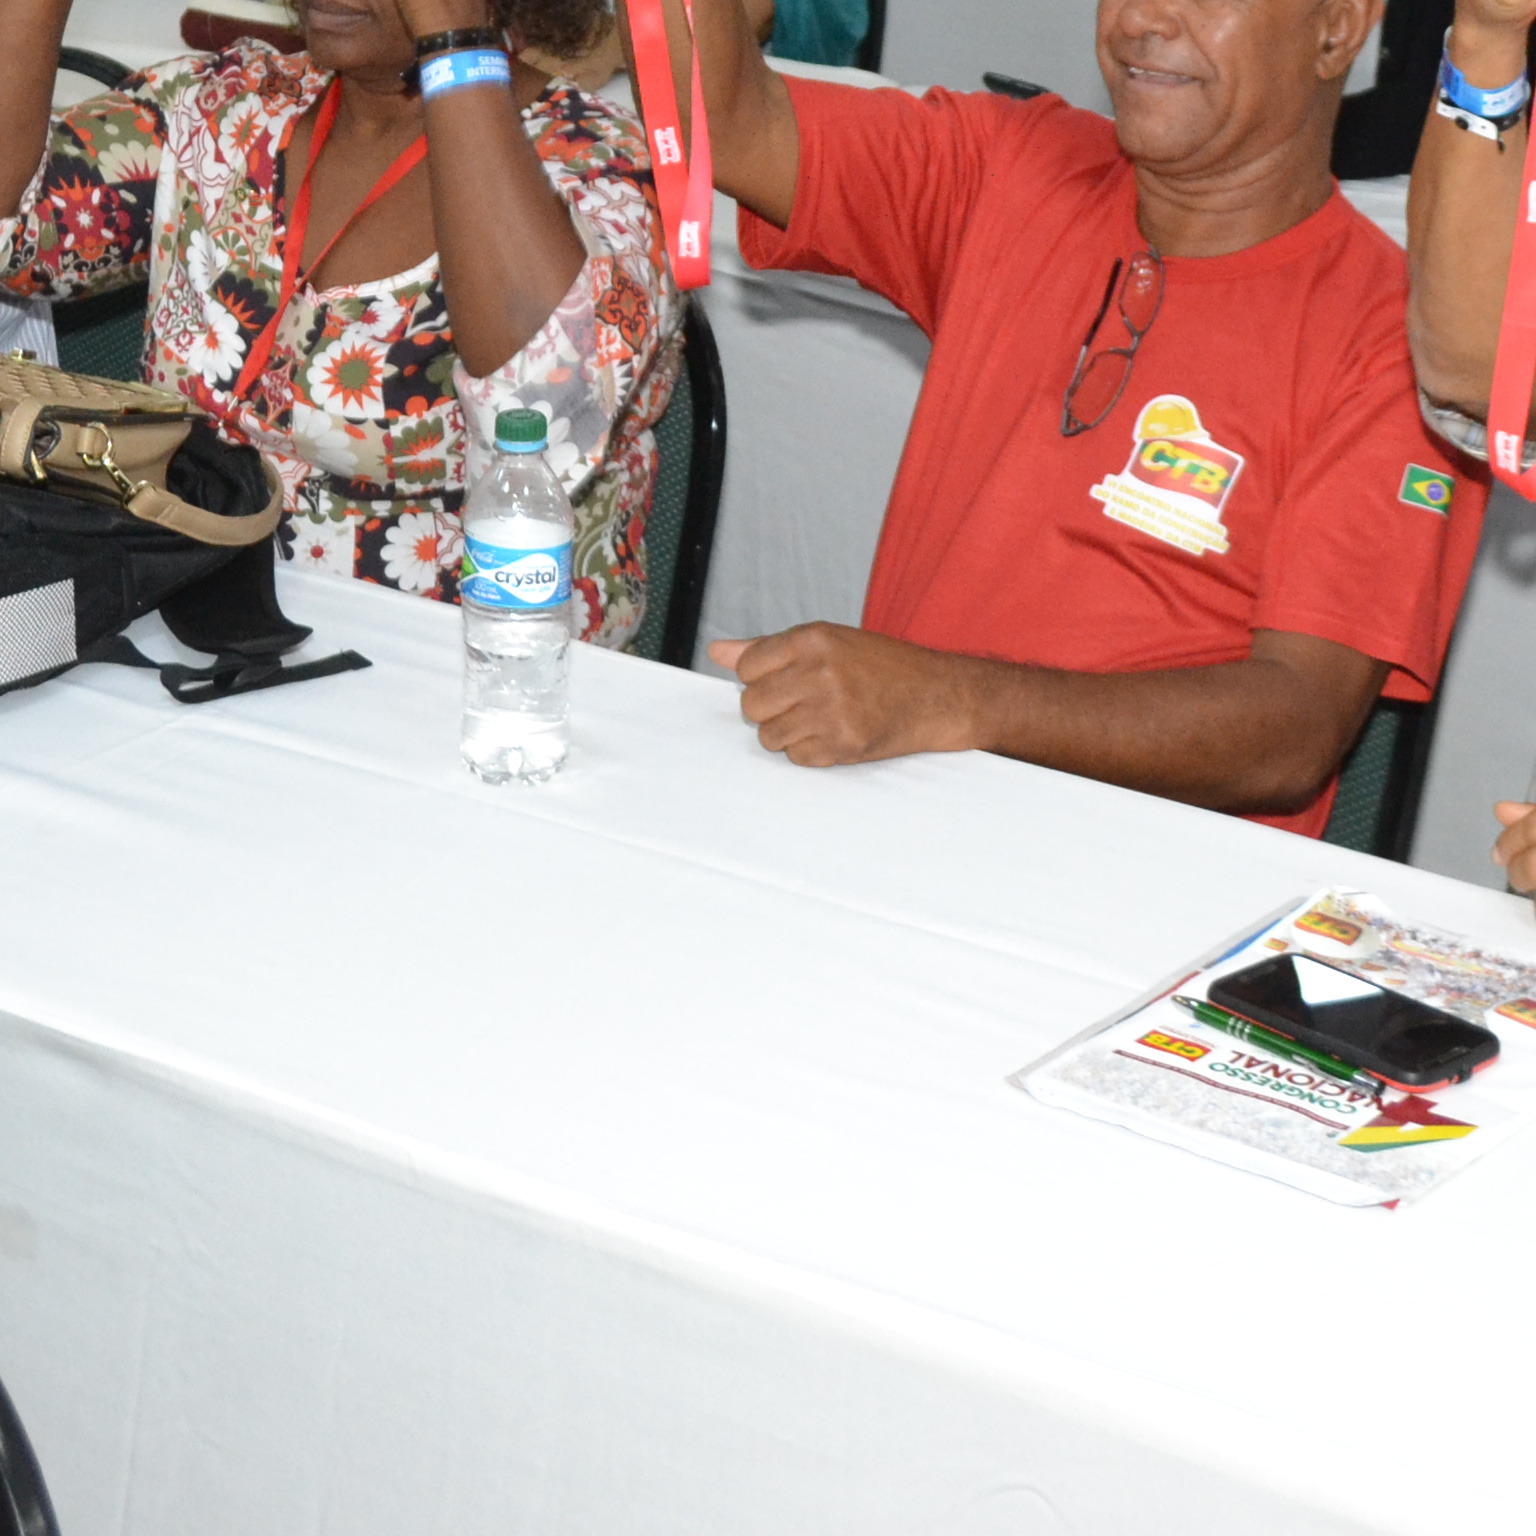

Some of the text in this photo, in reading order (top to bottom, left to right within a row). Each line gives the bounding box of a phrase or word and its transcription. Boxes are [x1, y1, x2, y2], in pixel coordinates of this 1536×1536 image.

[1140, 440, 1228, 494] CTB
[1095, 486, 1109, 499] DO
[1112, 493, 1140, 511] RAMO
[1142, 505, 1156, 519] DA
[1118, 481, 1171, 511] ENCONTRO
[1175, 507, 1225, 536] NACIONAL
[494, 566, 556, 588] crystal
[1143, 1033, 1206, 1059] CTB
[1208, 1061, 1357, 1116] CONGRESSO
[1229, 1049, 1384, 1111] NACIONAL
